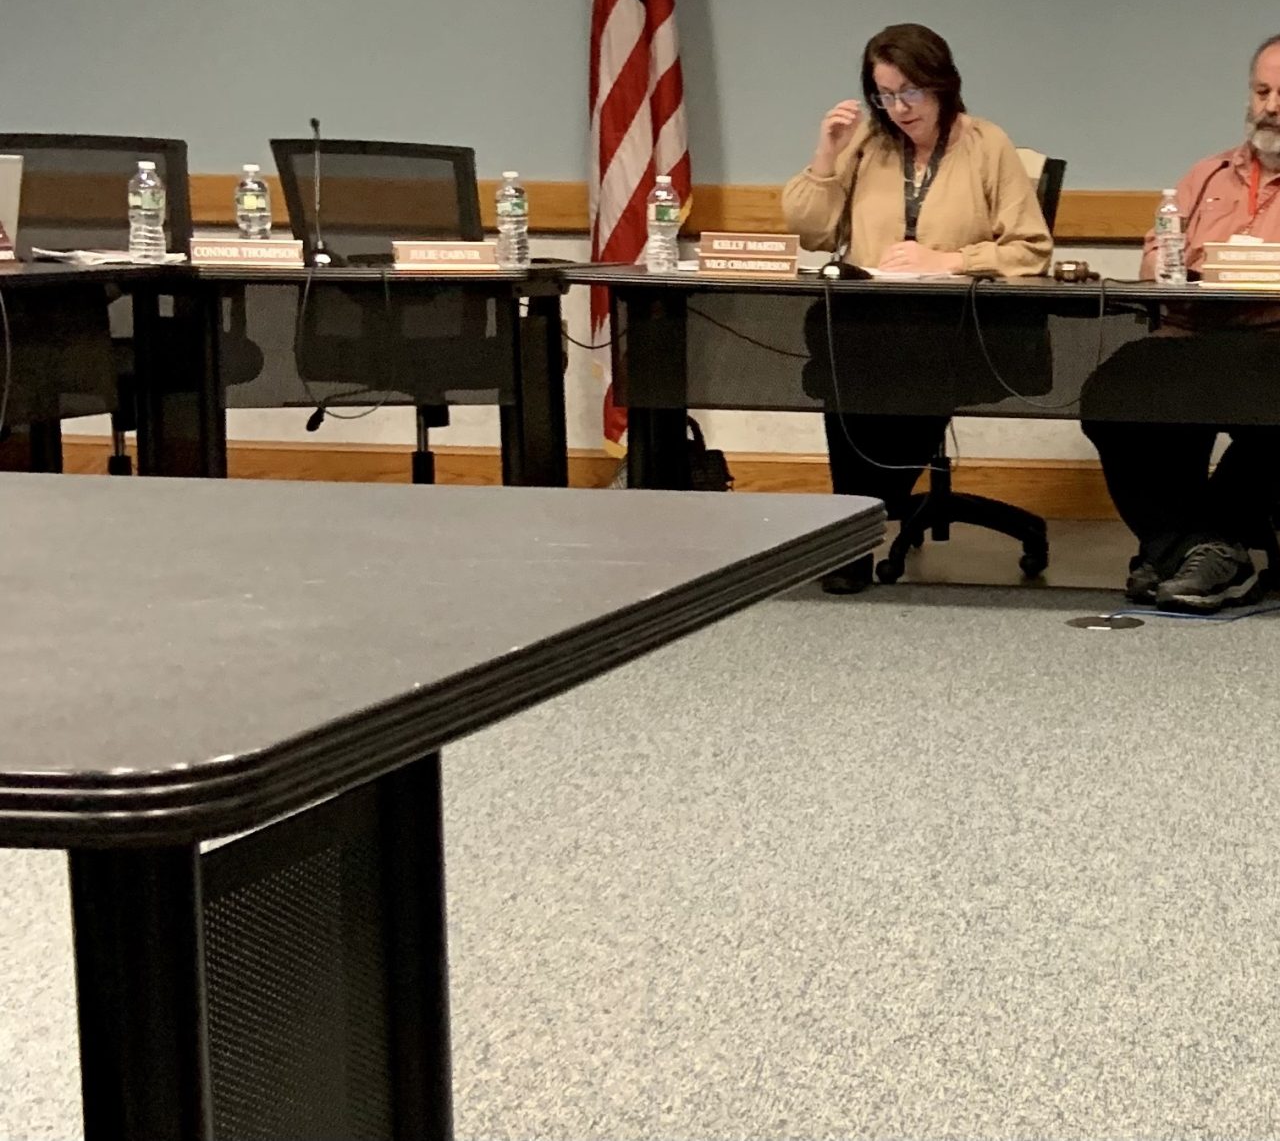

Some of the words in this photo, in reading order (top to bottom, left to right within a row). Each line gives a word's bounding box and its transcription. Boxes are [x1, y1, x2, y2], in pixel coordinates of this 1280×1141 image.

[713, 240, 745, 250] KELLY
[746, 241, 787, 252] MARTIN
[193, 246, 238, 259] CONNOR
[239, 247, 299, 260] THOMPSON
[704, 259, 727, 269] VICE
[728, 259, 791, 271] CHAIRPERSON
